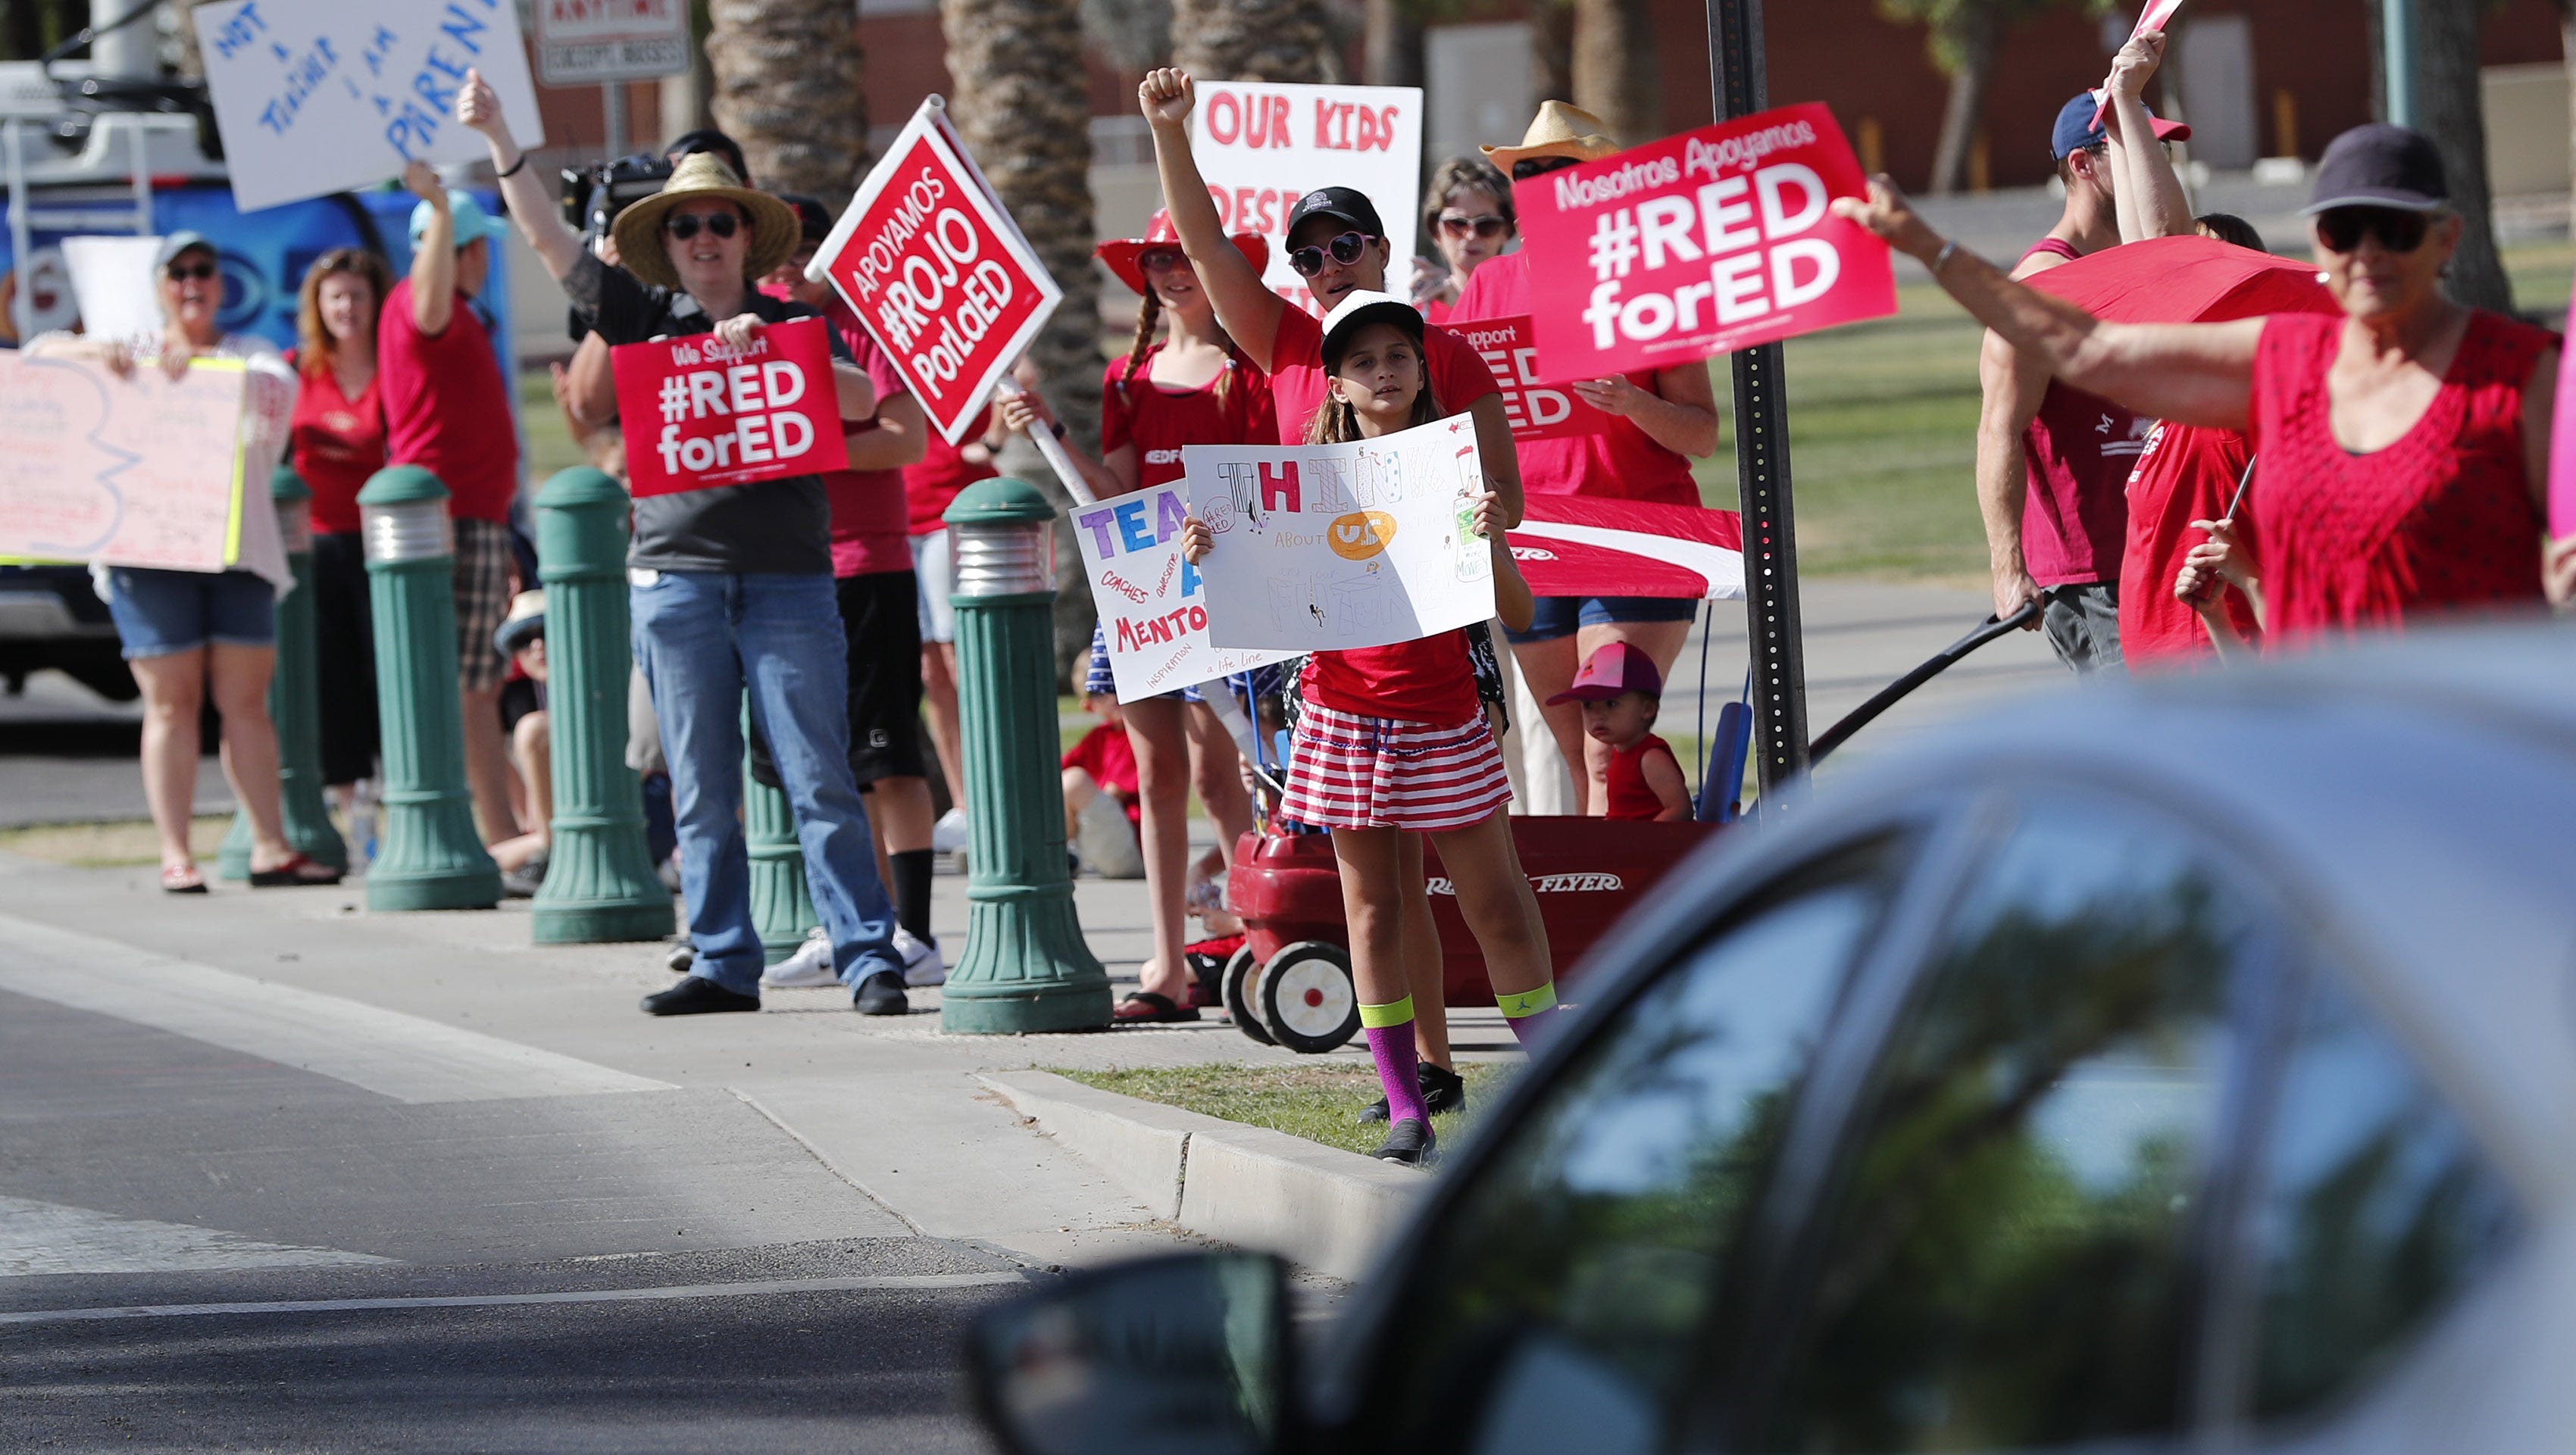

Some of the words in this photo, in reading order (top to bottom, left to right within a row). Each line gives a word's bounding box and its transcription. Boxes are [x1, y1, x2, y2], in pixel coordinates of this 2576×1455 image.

[1207, 91, 1292, 149] OUR
[1315, 98, 1400, 152] KIDS
[1554, 155, 1681, 213] Nosotros
[1683, 120, 1817, 183] Apoyamos
[851, 165, 946, 303] APOYAMOS
[1588, 162, 1829, 282] #RED
[877, 207, 980, 355] #ROJO
[1582, 238, 1841, 351] forED
[671, 342, 702, 367] We
[658, 360, 806, 424] #RED
[656, 410, 815, 476] forED
[1217, 438, 1449, 515] THINK
[1079, 490, 1190, 560] TEA
[1274, 532, 1325, 548] ABOUT
[1100, 570, 1149, 604] COACHES
[1155, 552, 1179, 598] awesome
[1456, 557, 1489, 577] MONEY
[1115, 604, 1208, 654] MENTO
[1146, 642, 1193, 690] INSPIRATION
[1206, 665, 1214, 673] a
[1218, 656, 1236, 673] life
[1240, 651, 1264, 667] line
[1535, 873, 1623, 893] FLYER
